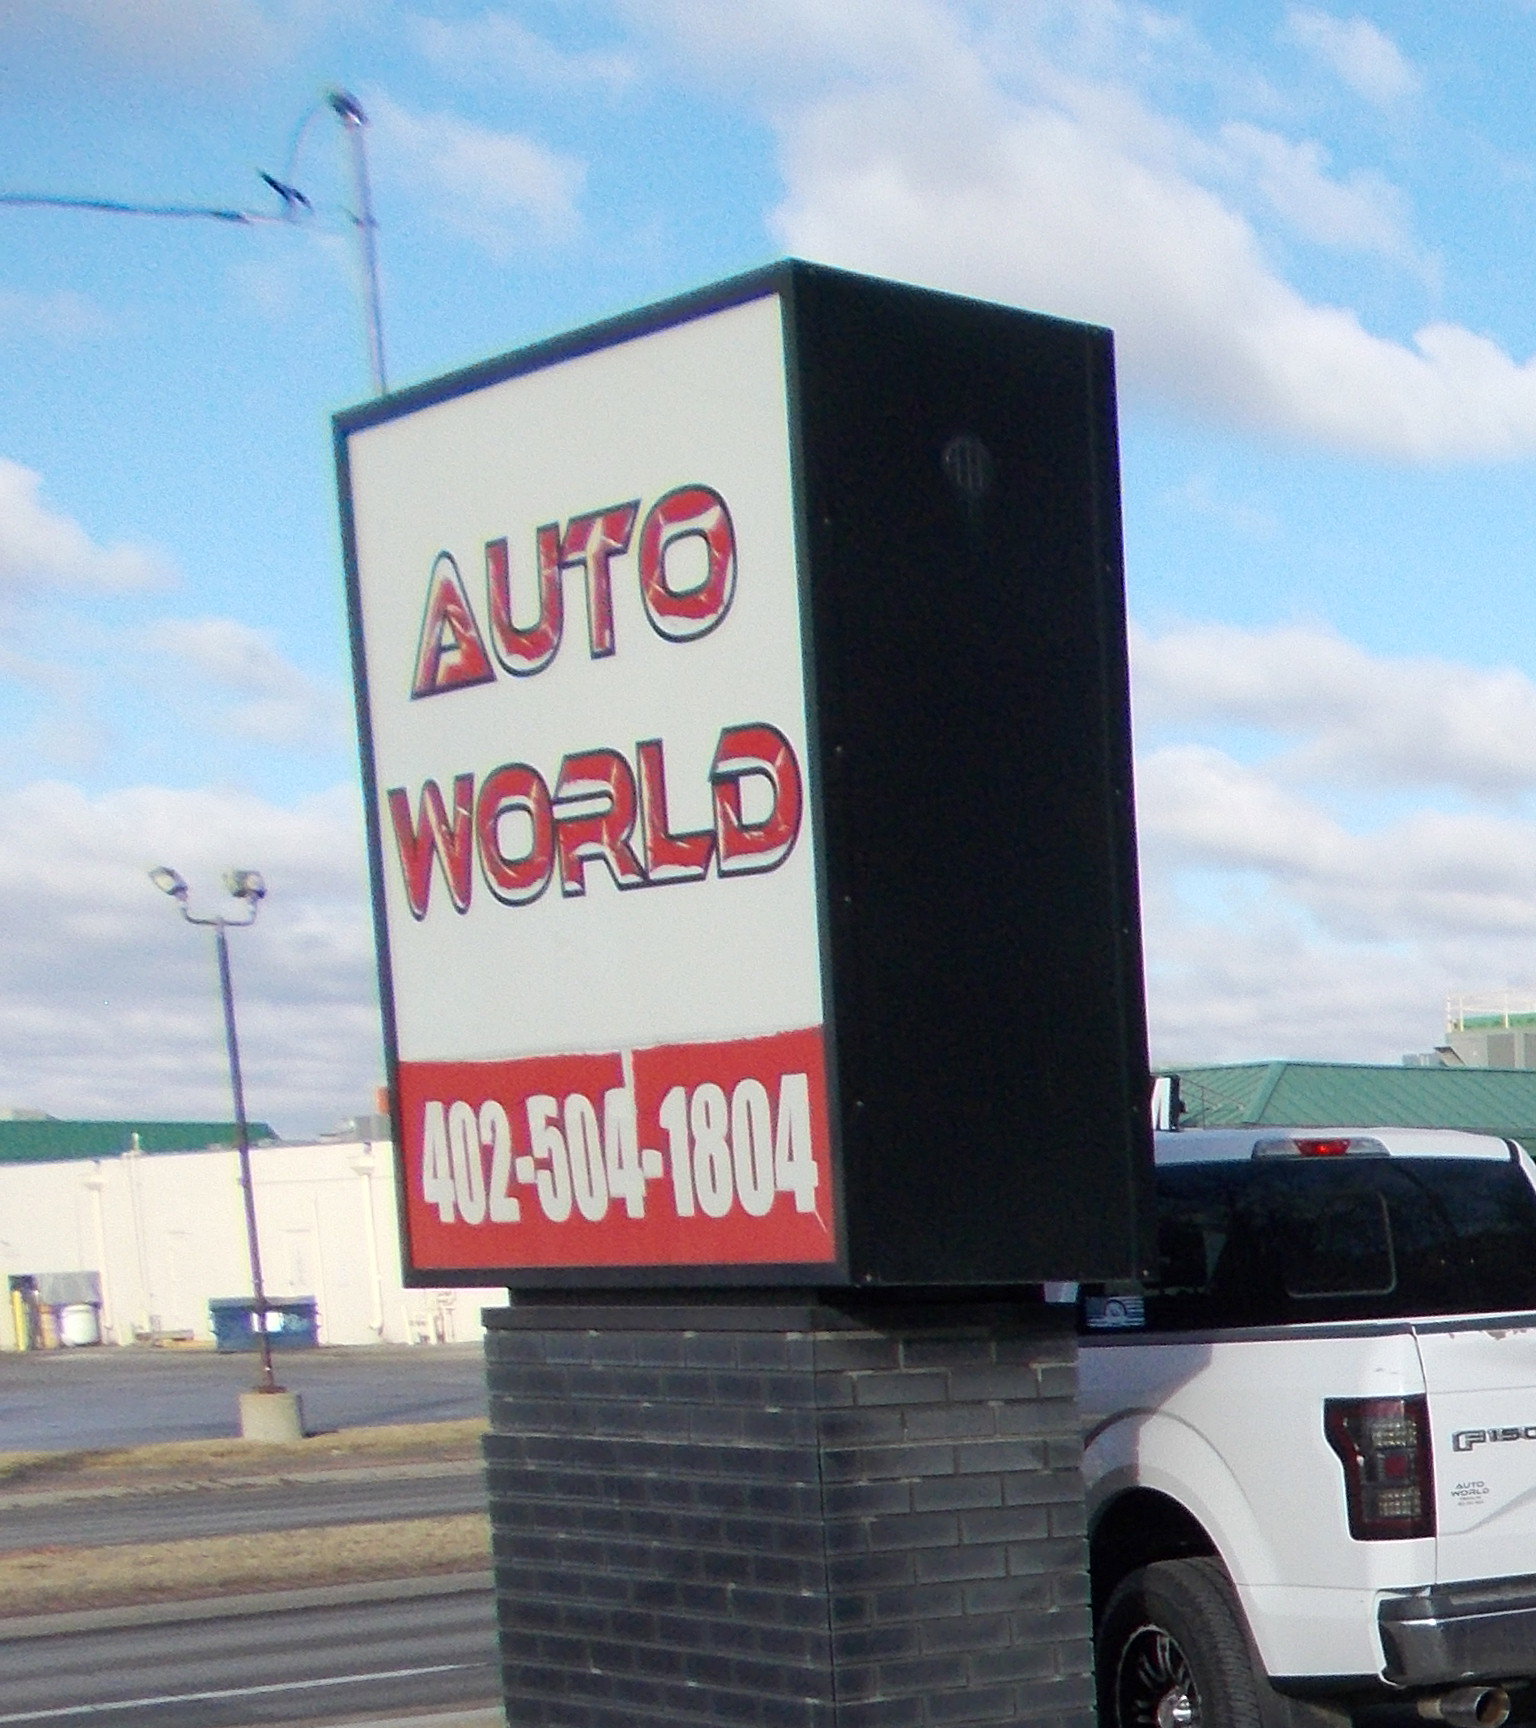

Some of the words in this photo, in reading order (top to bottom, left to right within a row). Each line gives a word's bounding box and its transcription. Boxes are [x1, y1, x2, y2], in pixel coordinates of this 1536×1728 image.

[410, 483, 738, 702] AUTO
[387, 722, 802, 922] WORLD
[421, 1070, 820, 1226] 402-504-1804
